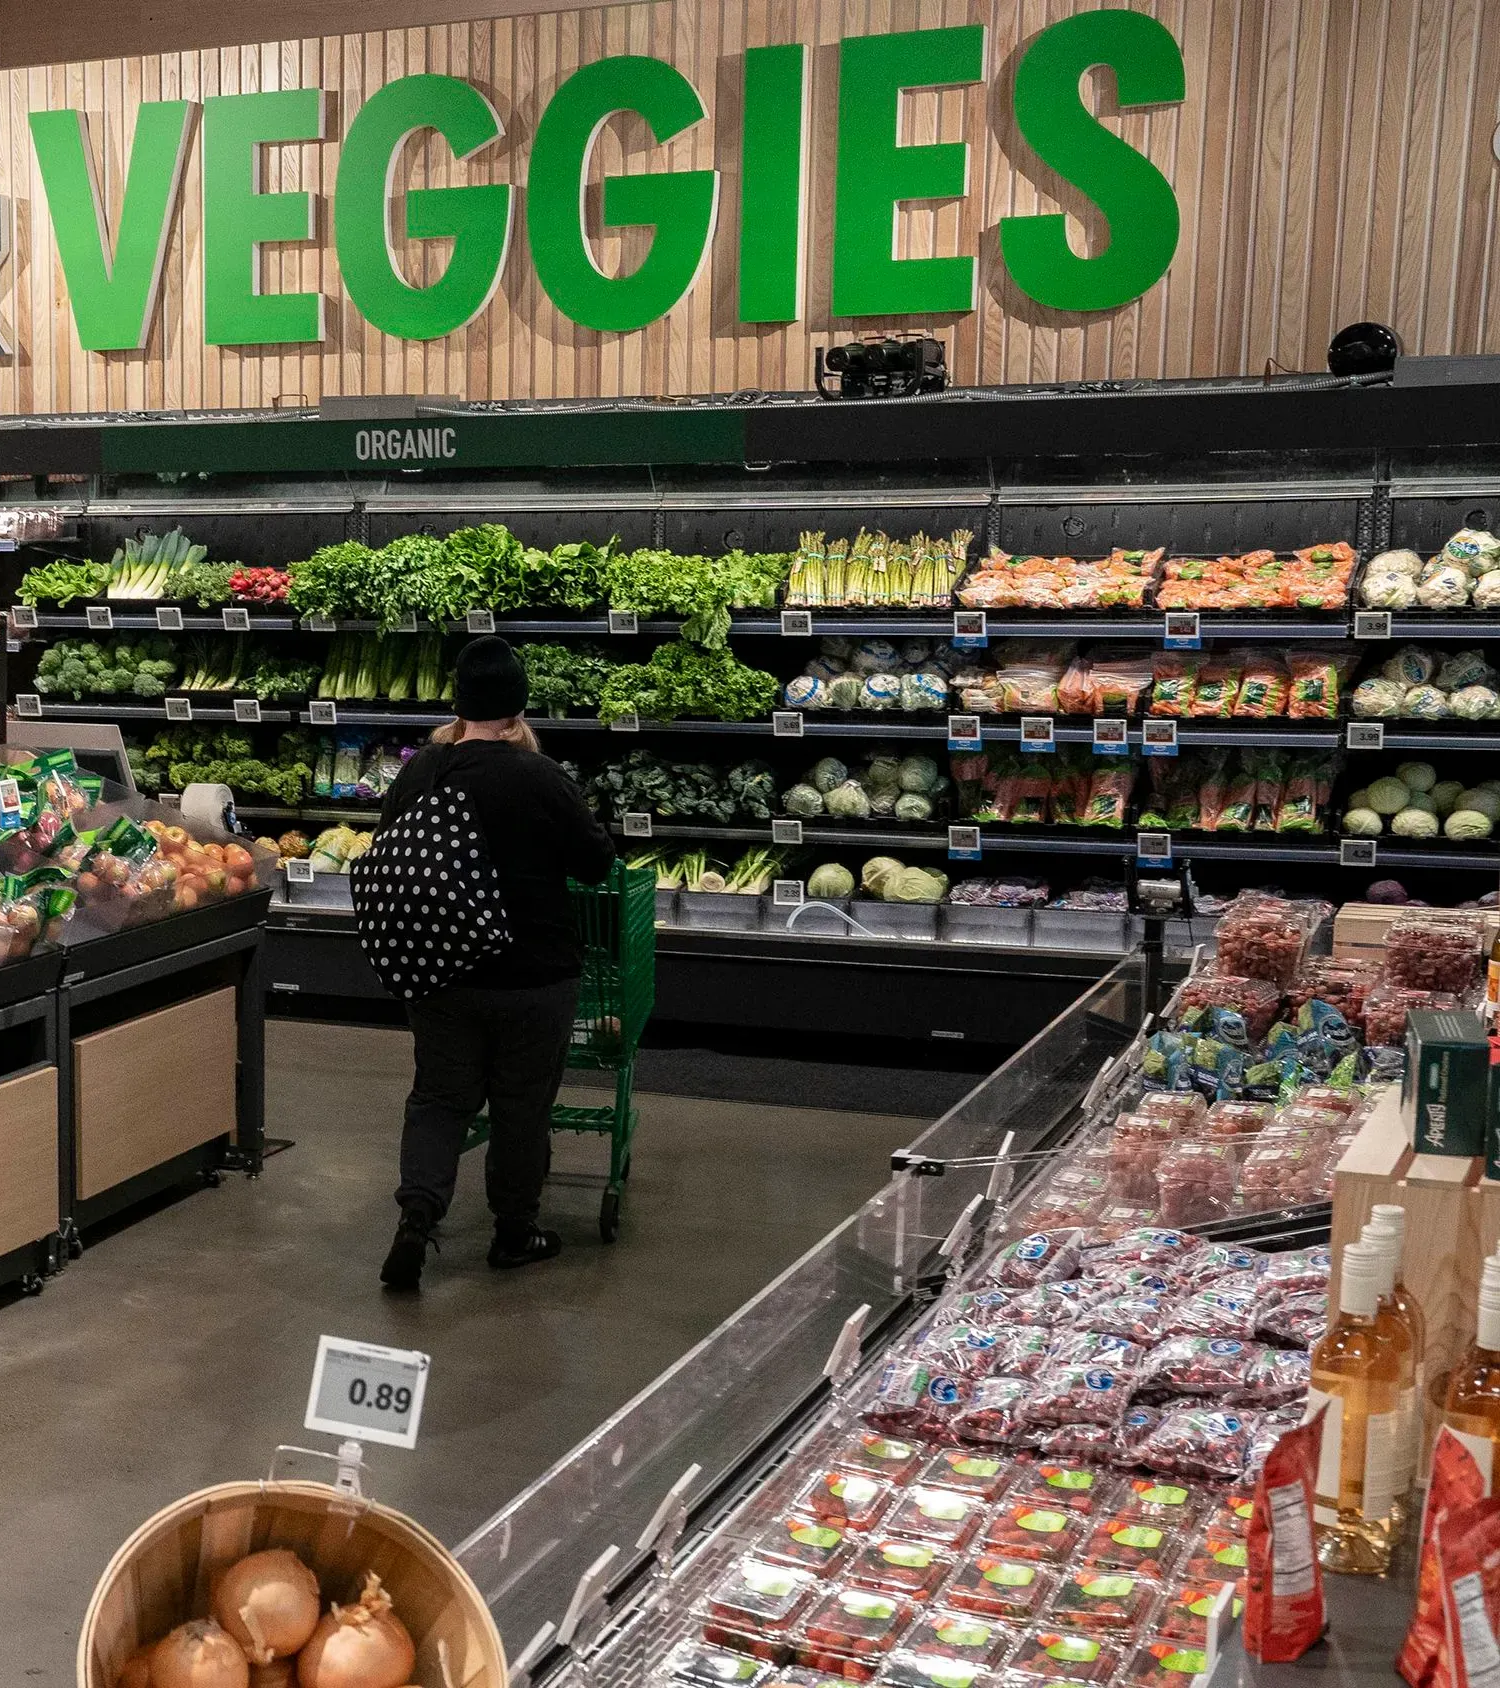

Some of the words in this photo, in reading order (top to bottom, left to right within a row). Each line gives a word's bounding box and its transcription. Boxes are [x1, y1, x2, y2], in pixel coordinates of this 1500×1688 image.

[29, 10, 1186, 353] VEGGIES
[355, 427, 456, 460] ORGANIC
[348, 1378, 412, 1414] 0.89
